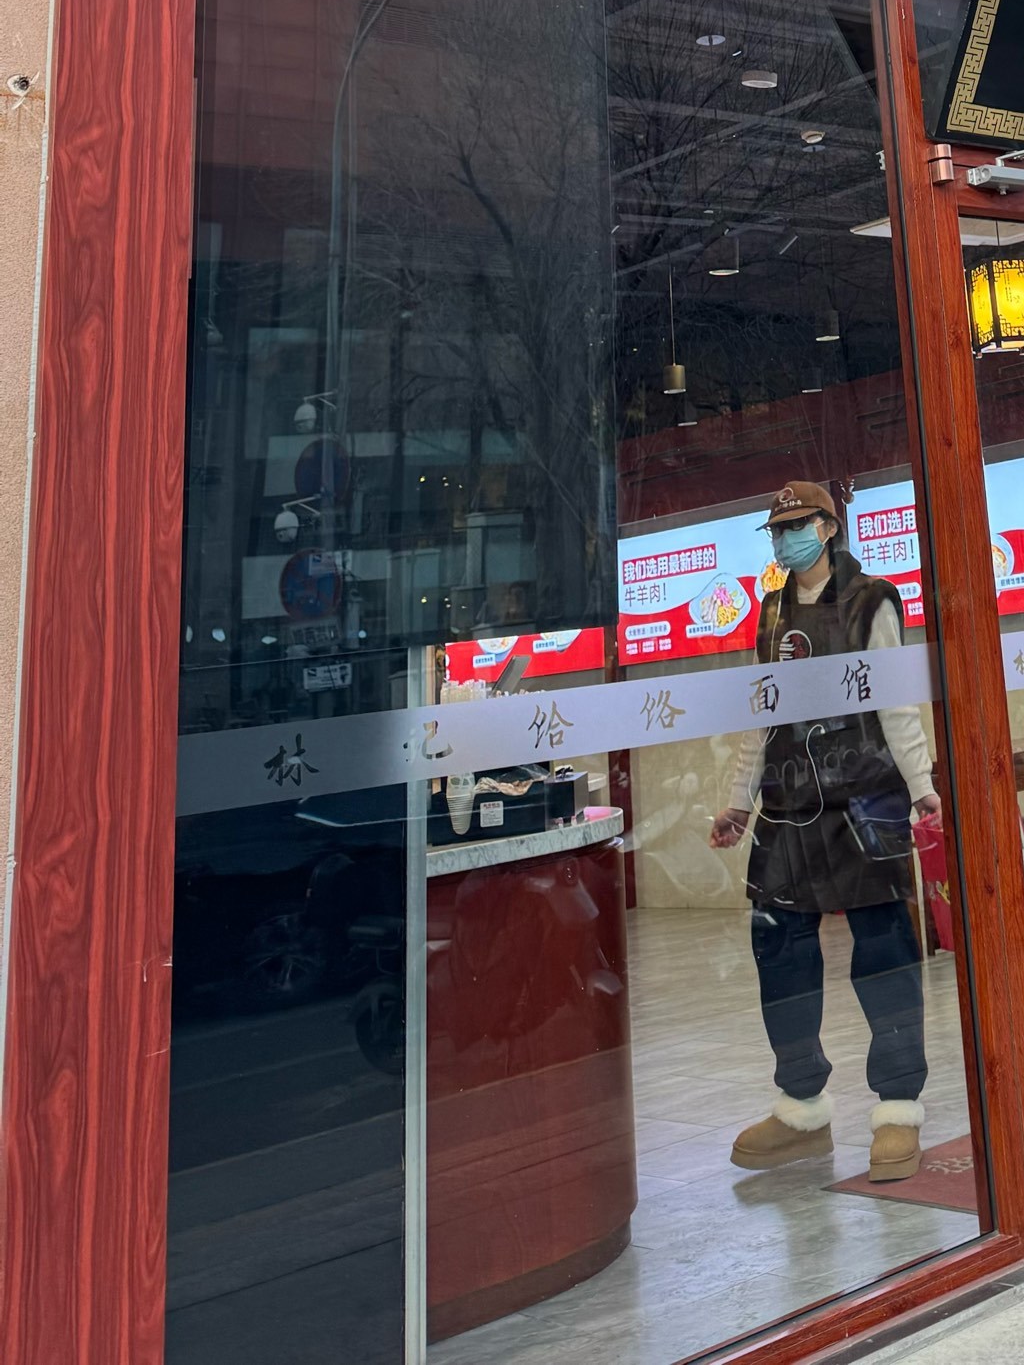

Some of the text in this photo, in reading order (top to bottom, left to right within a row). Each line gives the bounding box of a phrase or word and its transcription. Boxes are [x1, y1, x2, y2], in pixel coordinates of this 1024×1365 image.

[859, 508, 917, 539] 我们选用
[623, 546, 717, 582] 我们选用最新鲜的
